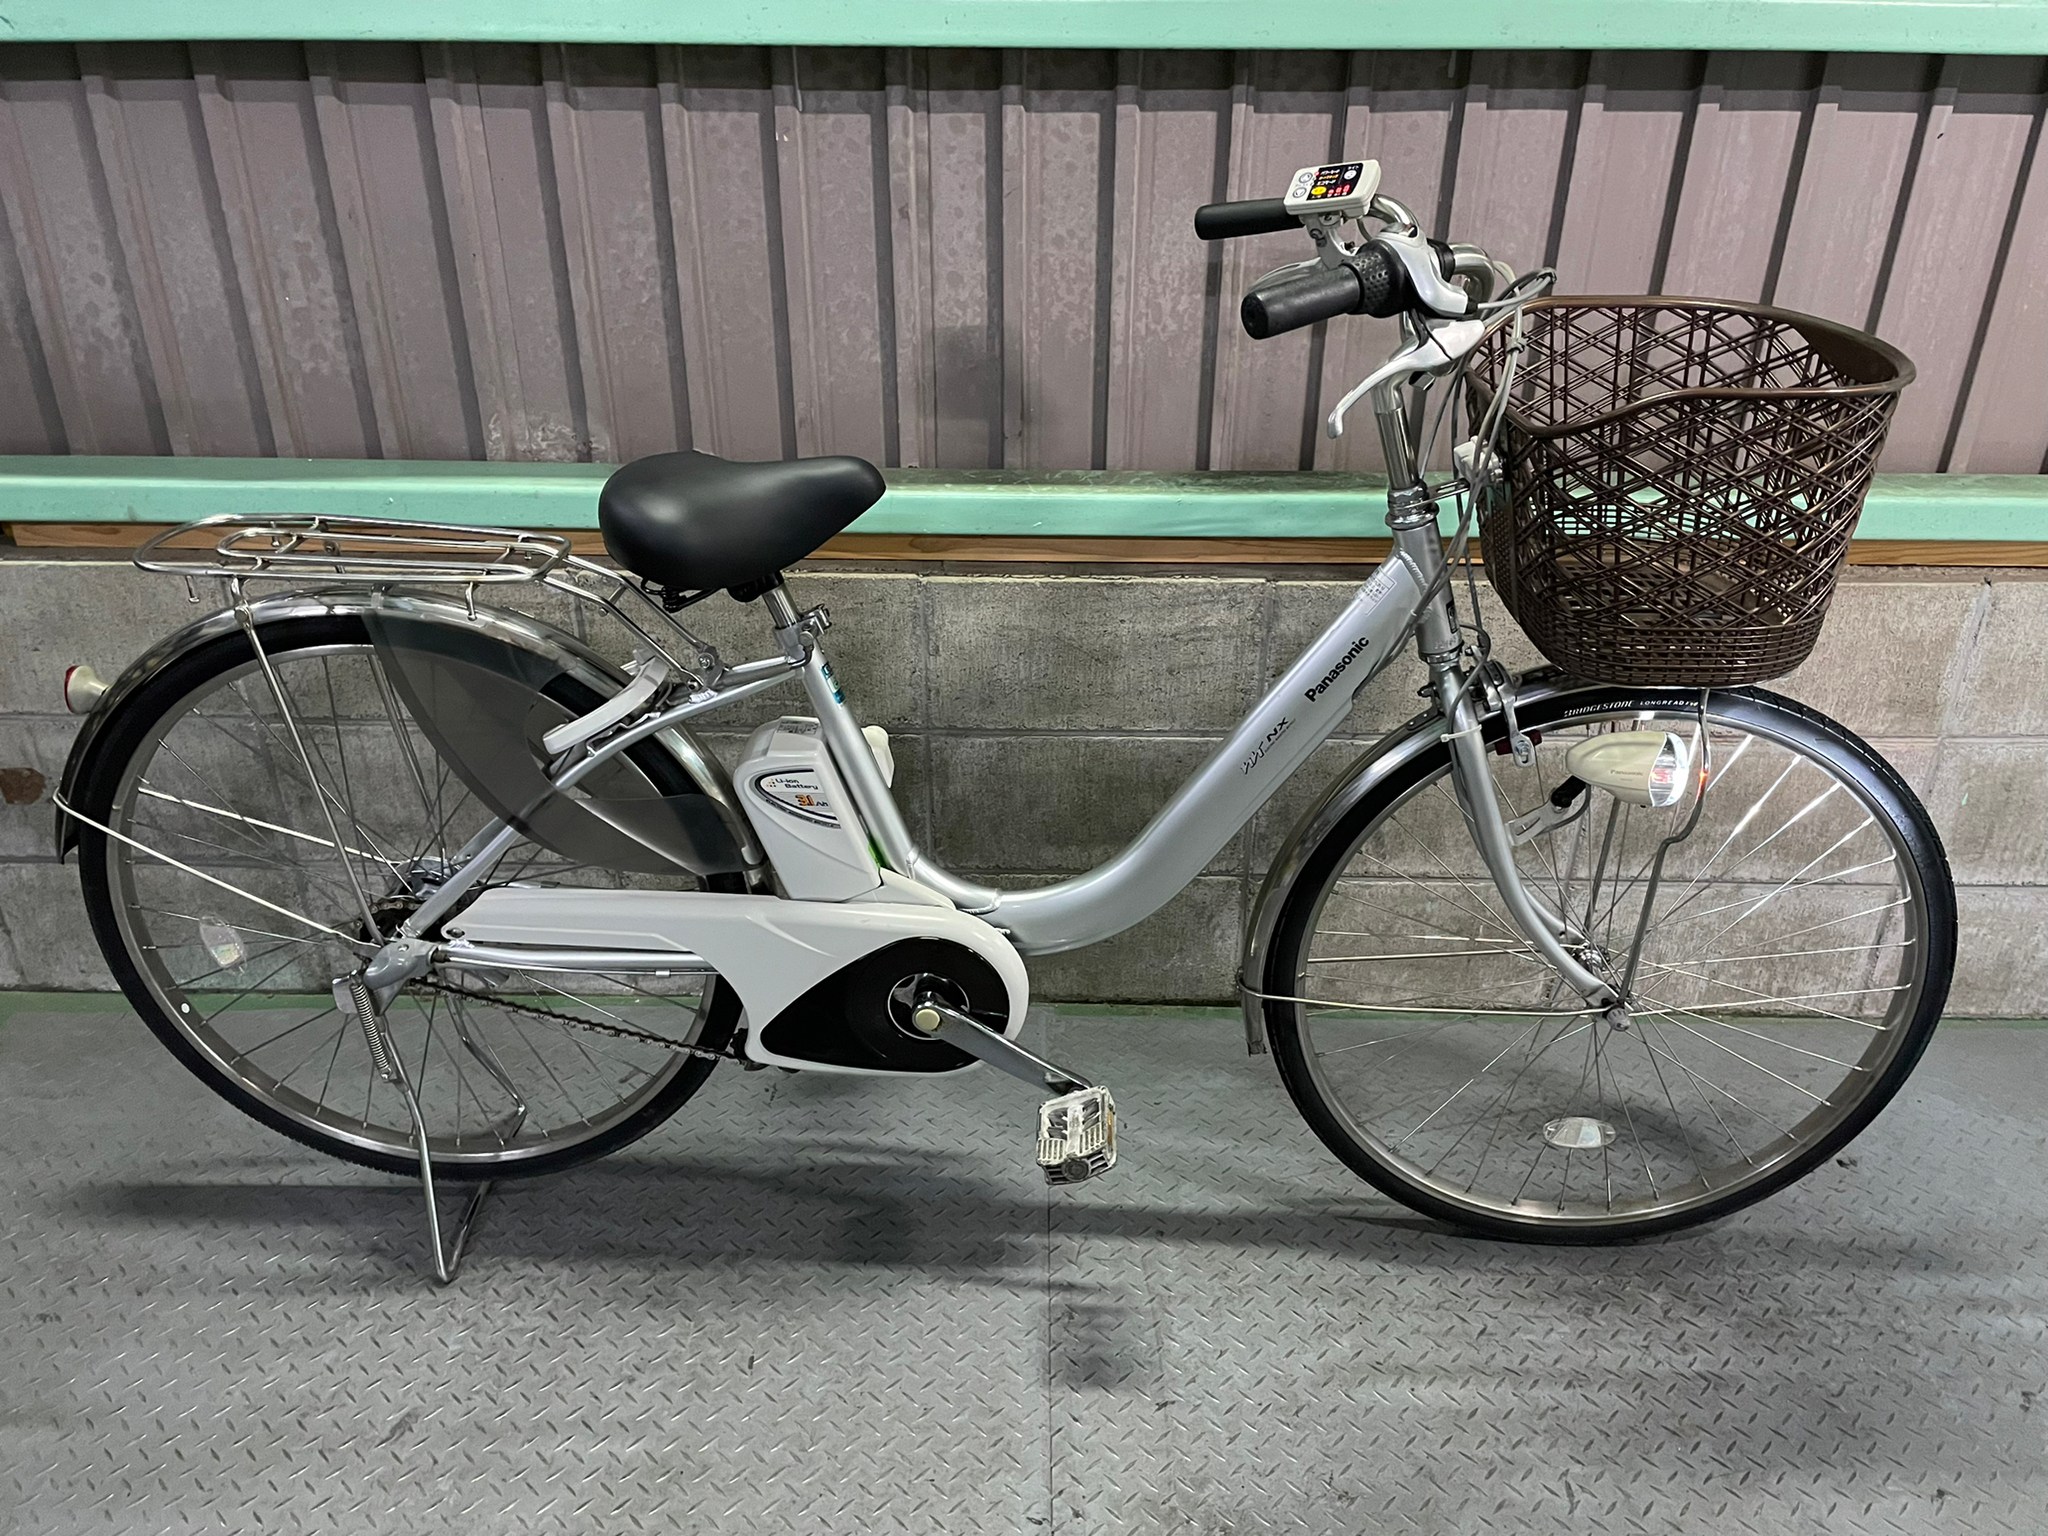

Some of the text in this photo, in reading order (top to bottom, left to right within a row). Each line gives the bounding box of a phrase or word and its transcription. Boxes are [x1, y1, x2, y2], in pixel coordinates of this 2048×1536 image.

[1304, 635, 1370, 703] Panasonic
[1564, 700, 1635, 718] BRIDGESTONE
[1266, 716, 1289, 744] NX
